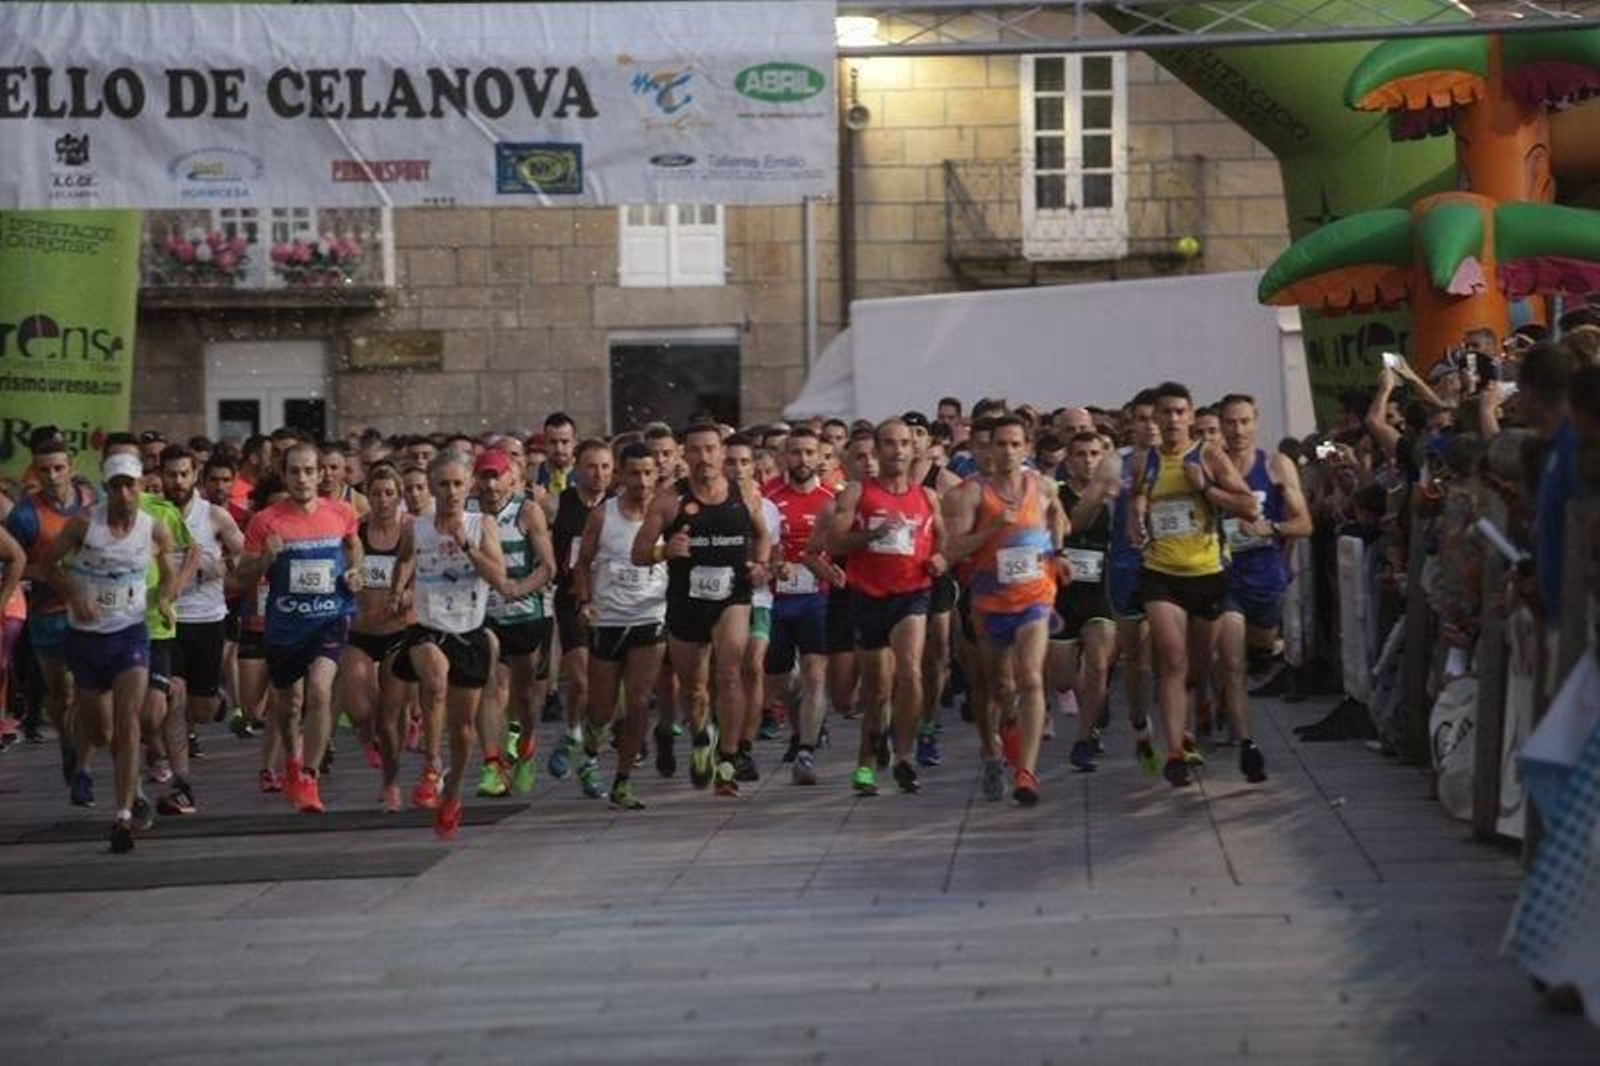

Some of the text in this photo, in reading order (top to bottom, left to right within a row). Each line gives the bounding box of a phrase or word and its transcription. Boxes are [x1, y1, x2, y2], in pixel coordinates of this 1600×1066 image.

[165, 68, 249, 118] DE
[266, 67, 598, 119] CELANOVA
[744, 69, 817, 95] ABRIL
